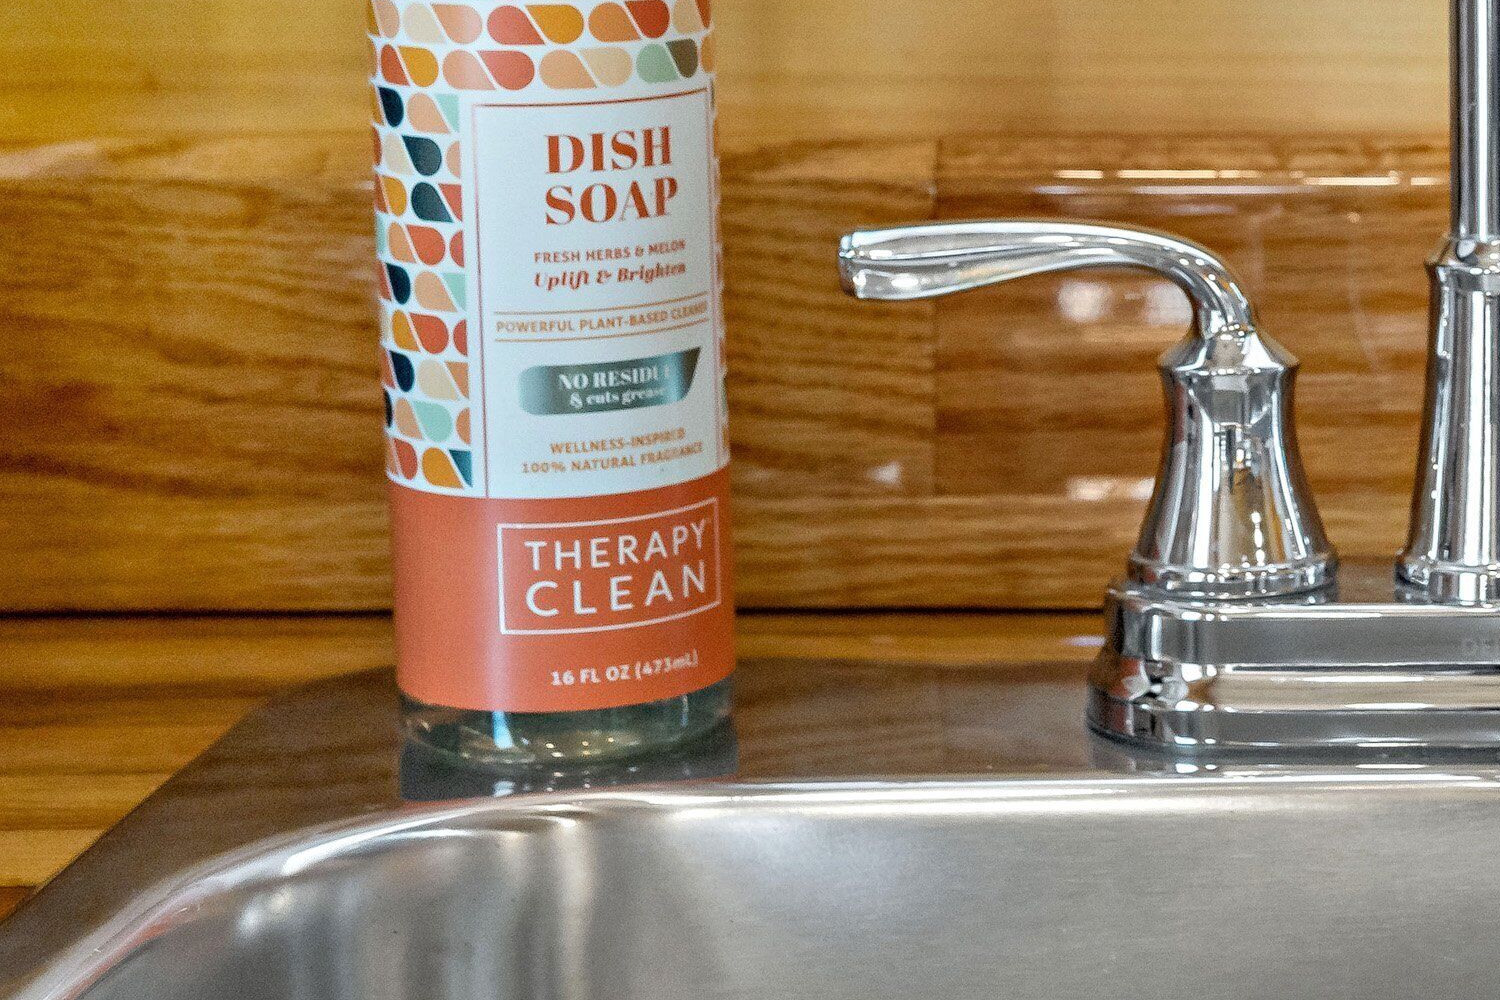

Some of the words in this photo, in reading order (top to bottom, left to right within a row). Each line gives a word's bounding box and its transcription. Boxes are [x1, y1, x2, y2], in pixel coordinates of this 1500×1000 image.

[543, 125, 672, 174] DISH
[544, 176, 678, 226] SOAP
[533, 249, 581, 264] FRESH
[585, 246, 631, 262] HERBS
[634, 244, 644, 257] &
[648, 239, 687, 255] MELON
[534, 269, 590, 291] Uplift
[596, 269, 613, 284] &
[617, 262, 687, 285] Brighten
[496, 319, 575, 333] POWERFUL
[579, 310, 668, 331] PLANT-BASED
[558, 372, 589, 391] NO
[570, 391, 583, 410] &
[586, 391, 619, 406] cuts
[522, 461, 567, 474] 100%
[571, 455, 636, 472] NATURAL
[524, 518, 707, 571] THERAPY
[525, 559, 706, 617] CLEAN
[551, 670, 575, 686] 16
[580, 668, 601, 684] FL
[605, 664, 631, 682] OZ
